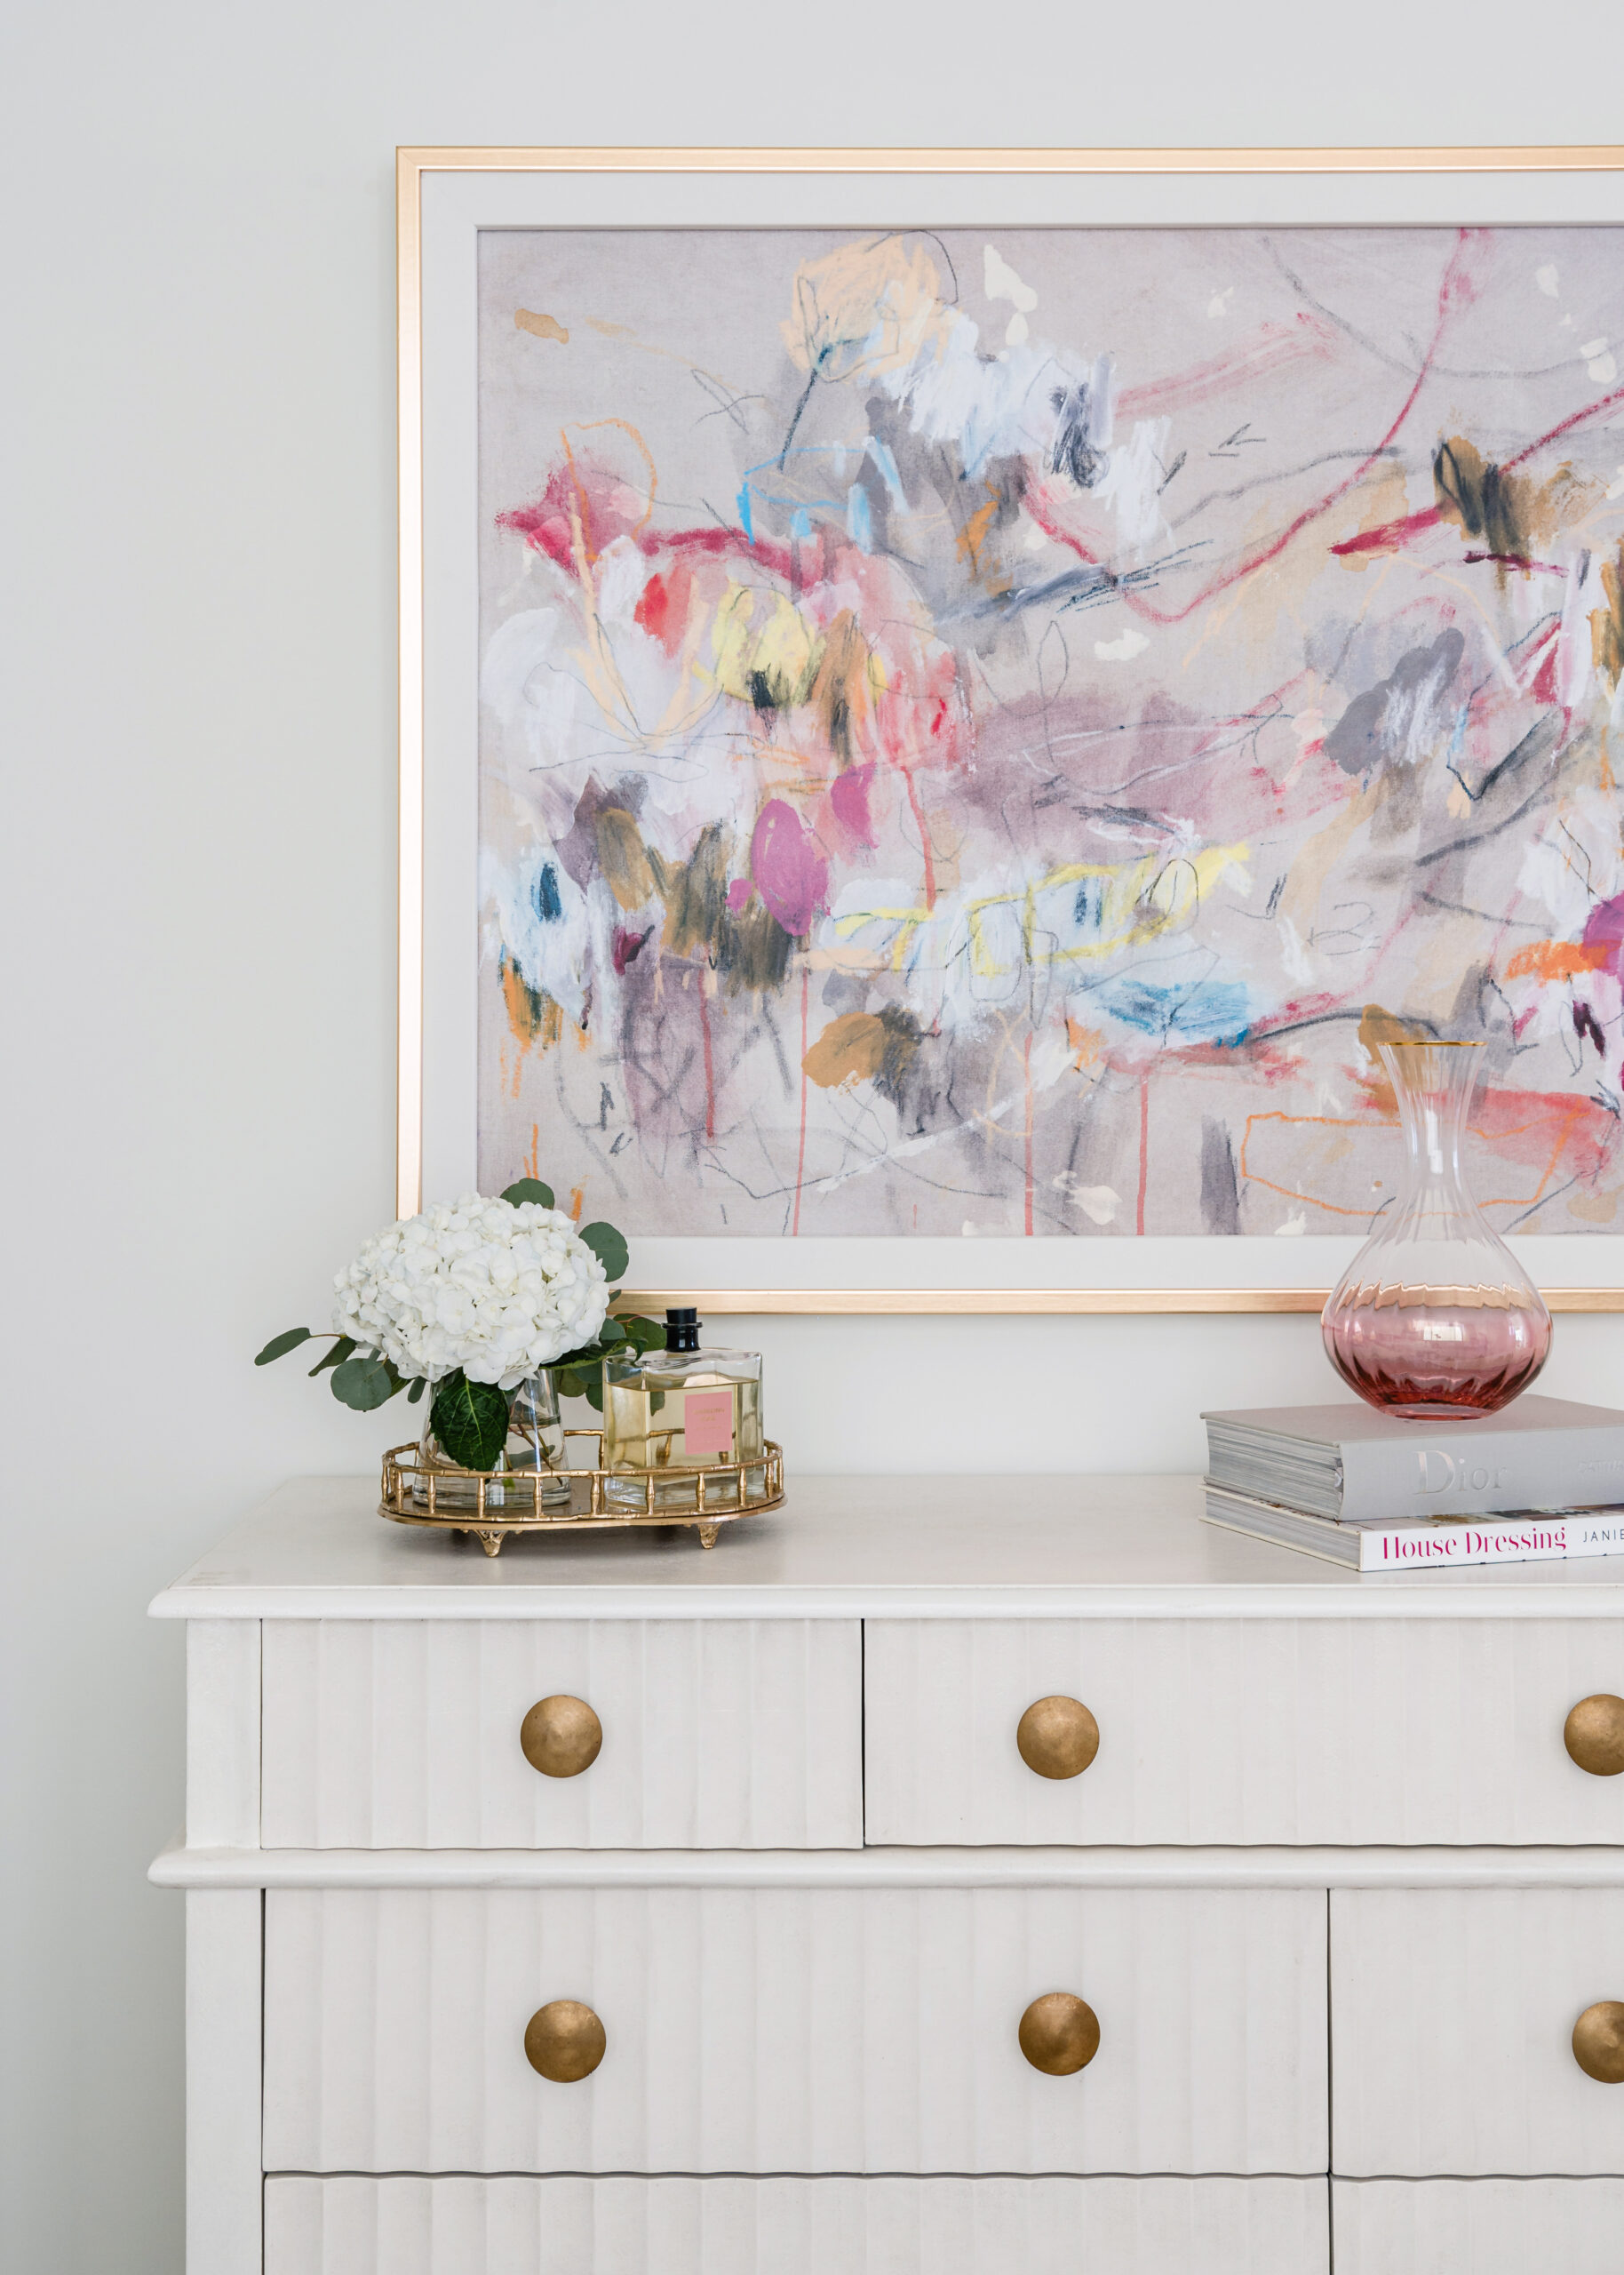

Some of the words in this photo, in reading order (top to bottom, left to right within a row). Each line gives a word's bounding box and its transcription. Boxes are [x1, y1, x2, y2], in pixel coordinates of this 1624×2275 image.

[1413, 1449, 1508, 1496] Dior
[1383, 1536, 1457, 1560] House
[1466, 1527, 1567, 1553] Dressing
[1583, 1528, 1624, 1543] JANIE
